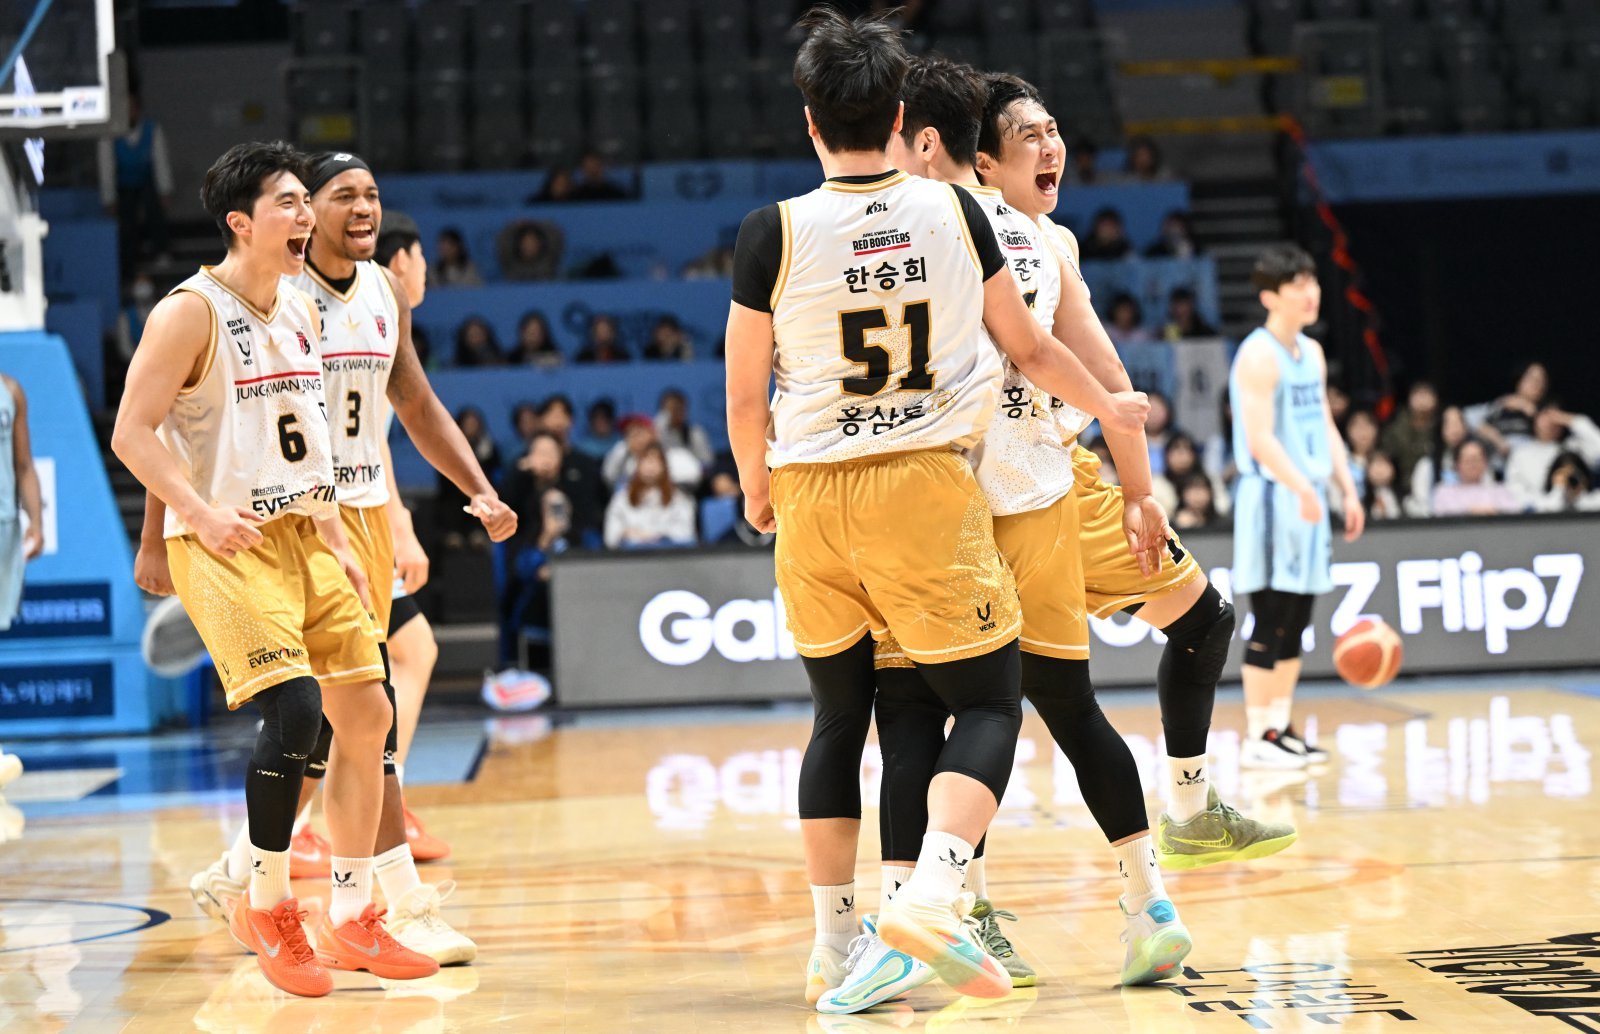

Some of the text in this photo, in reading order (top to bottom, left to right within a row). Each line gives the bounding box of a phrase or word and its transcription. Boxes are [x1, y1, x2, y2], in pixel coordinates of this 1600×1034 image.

[852, 231, 911, 251] RED BOOSTERS
[843, 256, 927, 294] 한승희
[342, 359, 372, 372] KWAN
[837, 298, 938, 398] 51
[345, 390, 362, 438] 3
[277, 412, 308, 463] 6
[1396, 550, 1585, 655] Flip7
[979, 621, 996, 632] VEXX
